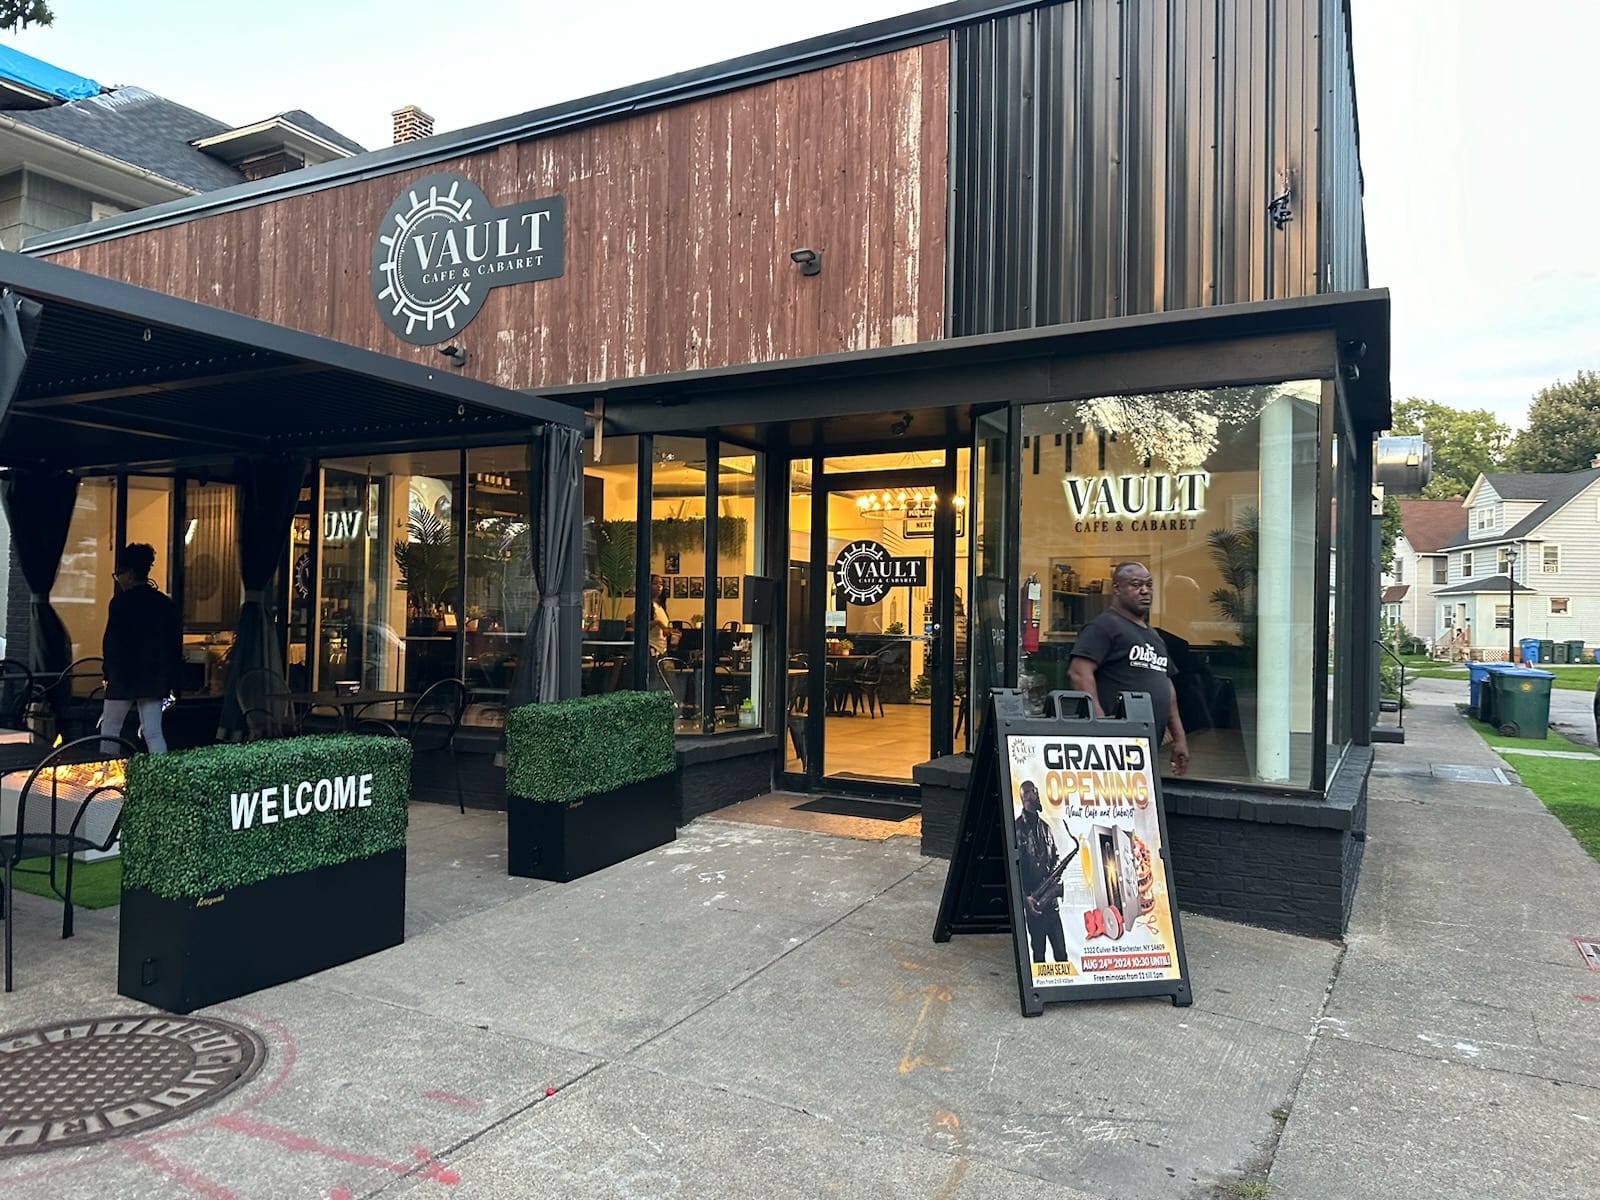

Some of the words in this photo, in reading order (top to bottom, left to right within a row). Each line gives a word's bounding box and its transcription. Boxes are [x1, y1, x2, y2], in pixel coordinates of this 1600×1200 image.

[412, 210, 550, 270] VAULT
[422, 270, 456, 285] CAFE
[462, 267, 471, 278] &
[478, 255, 544, 275] CABARET
[1065, 472, 1208, 516] VAULT
[1075, 521, 1109, 533] CAFE
[1116, 522, 1124, 531] &
[1131, 519, 1197, 532] CABARET
[853, 560, 920, 578] VAULT
[1044, 743, 1145, 771] GRAND
[230, 773, 373, 831] WELCOME
[1045, 771, 1149, 810] OPENING
[1065, 805, 1083, 818] Vault
[1085, 805, 1098, 819] Cafe
[1100, 808, 1110, 817] and
[1037, 964, 1054, 976] JUDAH
[1055, 963, 1071, 975] SEALY
[1083, 959, 1098, 970] AUG
[1114, 957, 1131, 968] 2024
[1131, 956, 1150, 967] 10:30
[1094, 974, 1105, 982] Free
[1106, 973, 1126, 981] mimosas
[1127, 972, 1138, 980] from
